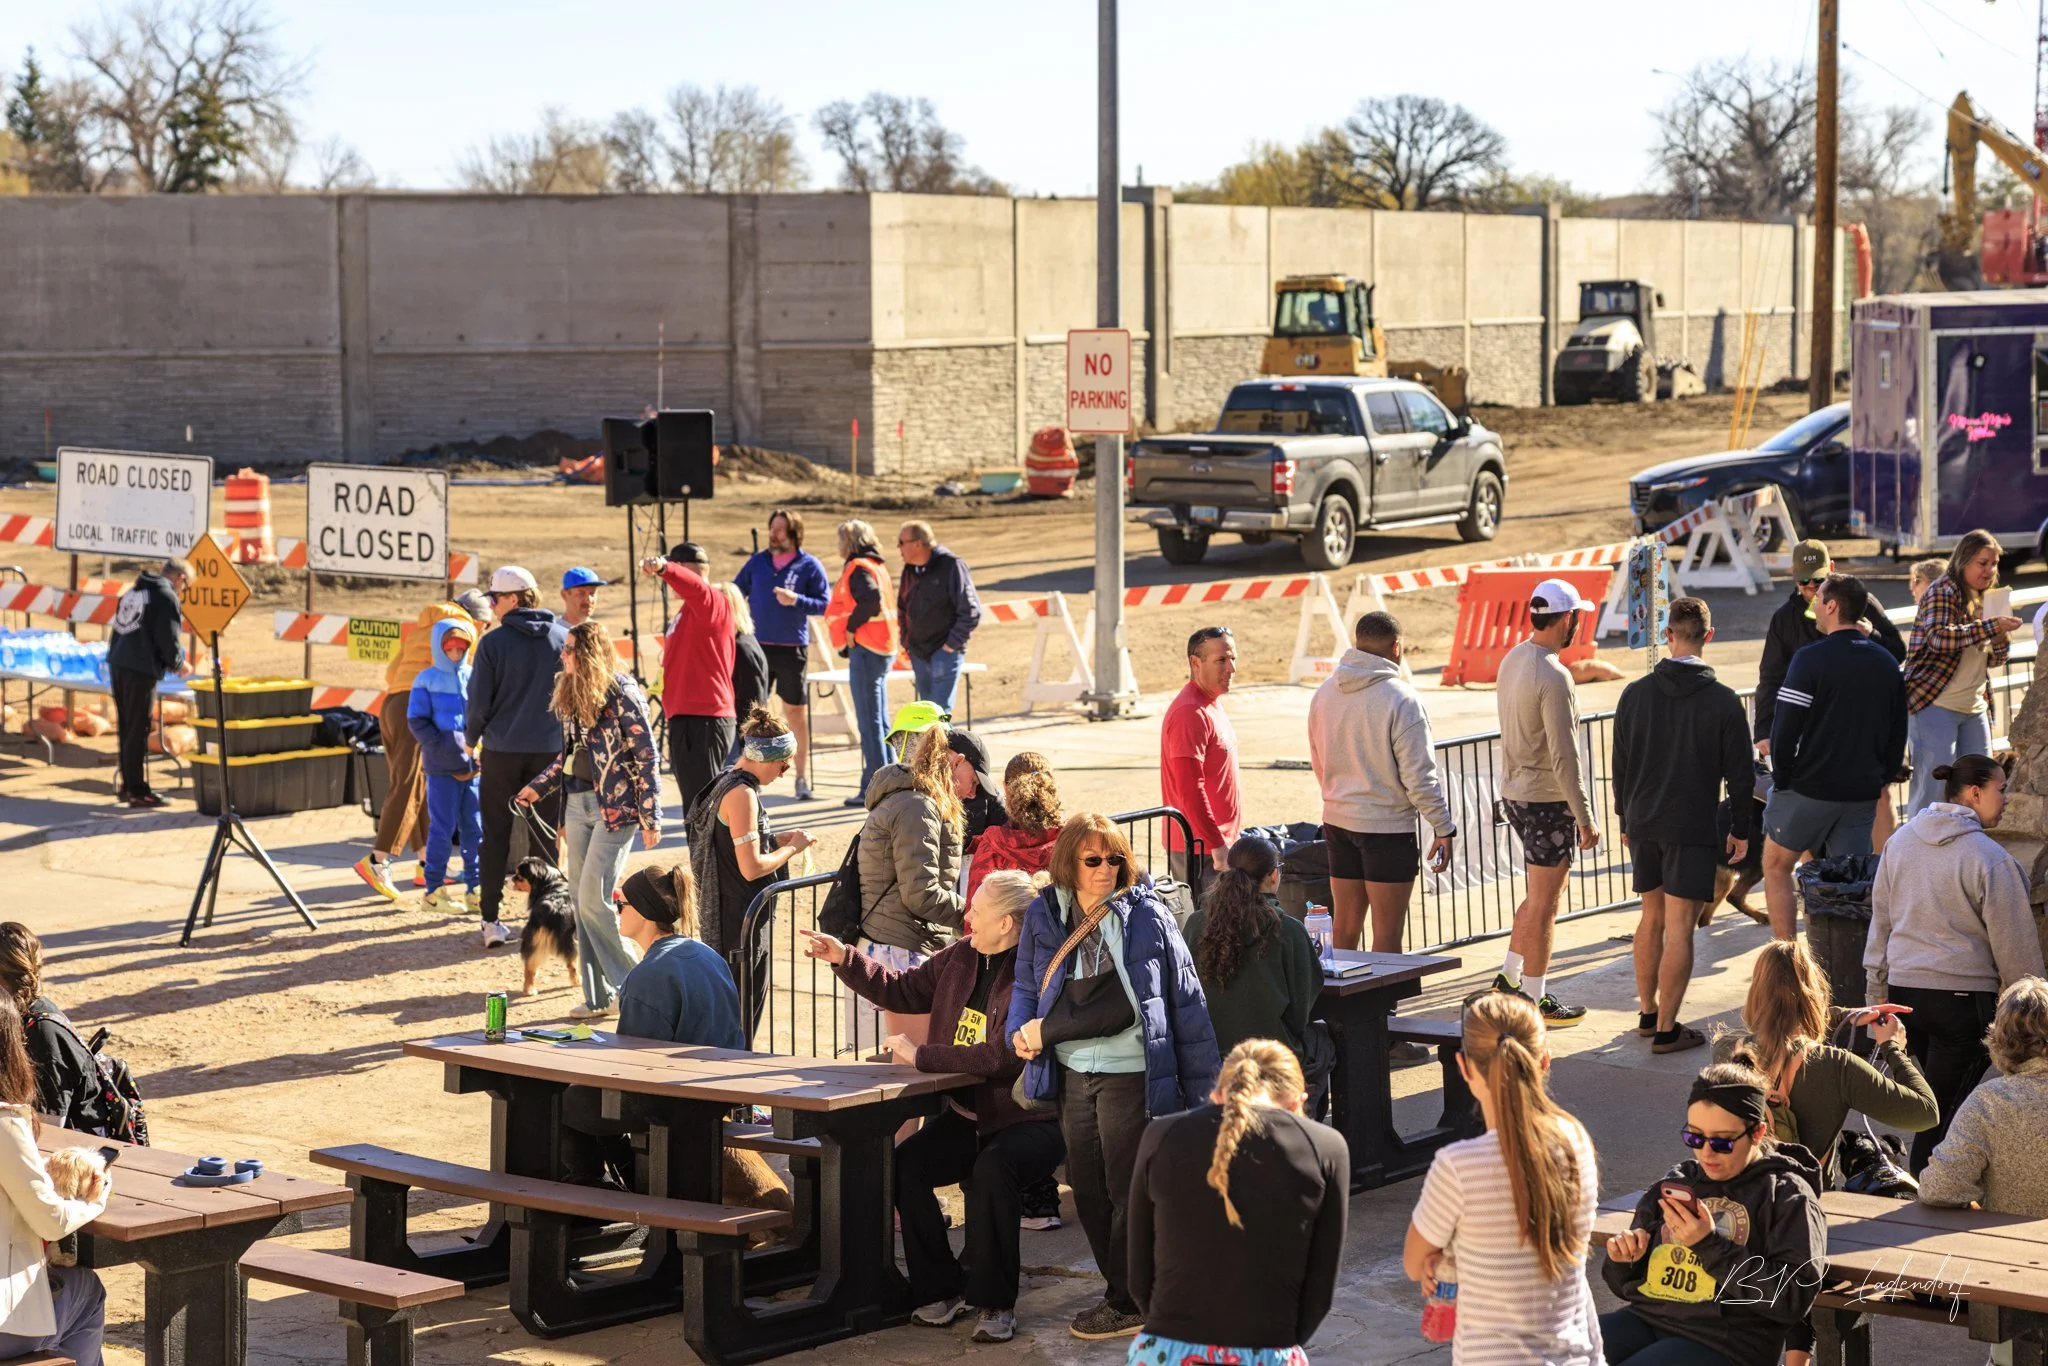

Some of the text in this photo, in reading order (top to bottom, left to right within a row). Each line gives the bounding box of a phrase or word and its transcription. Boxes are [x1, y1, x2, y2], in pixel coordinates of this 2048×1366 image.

[1085, 353, 1112, 376] NO
[1070, 390, 1127, 409] PARKING
[77, 462, 191, 491] ROAD CLOSED
[334, 482, 415, 516] ROAD
[68, 524, 194, 548] LOCAL TRAFFIC ONLY
[320, 526, 434, 562] CLOSED
[196, 558, 218, 578] NO
[351, 620, 399, 637] CAUTION
[357, 637, 391, 649] DO NOT
[359, 649, 389, 661] ENTER
[971, 1013, 982, 1025] 5K
[957, 1025, 976, 1045] 03
[1661, 1266, 1697, 1293] 308
